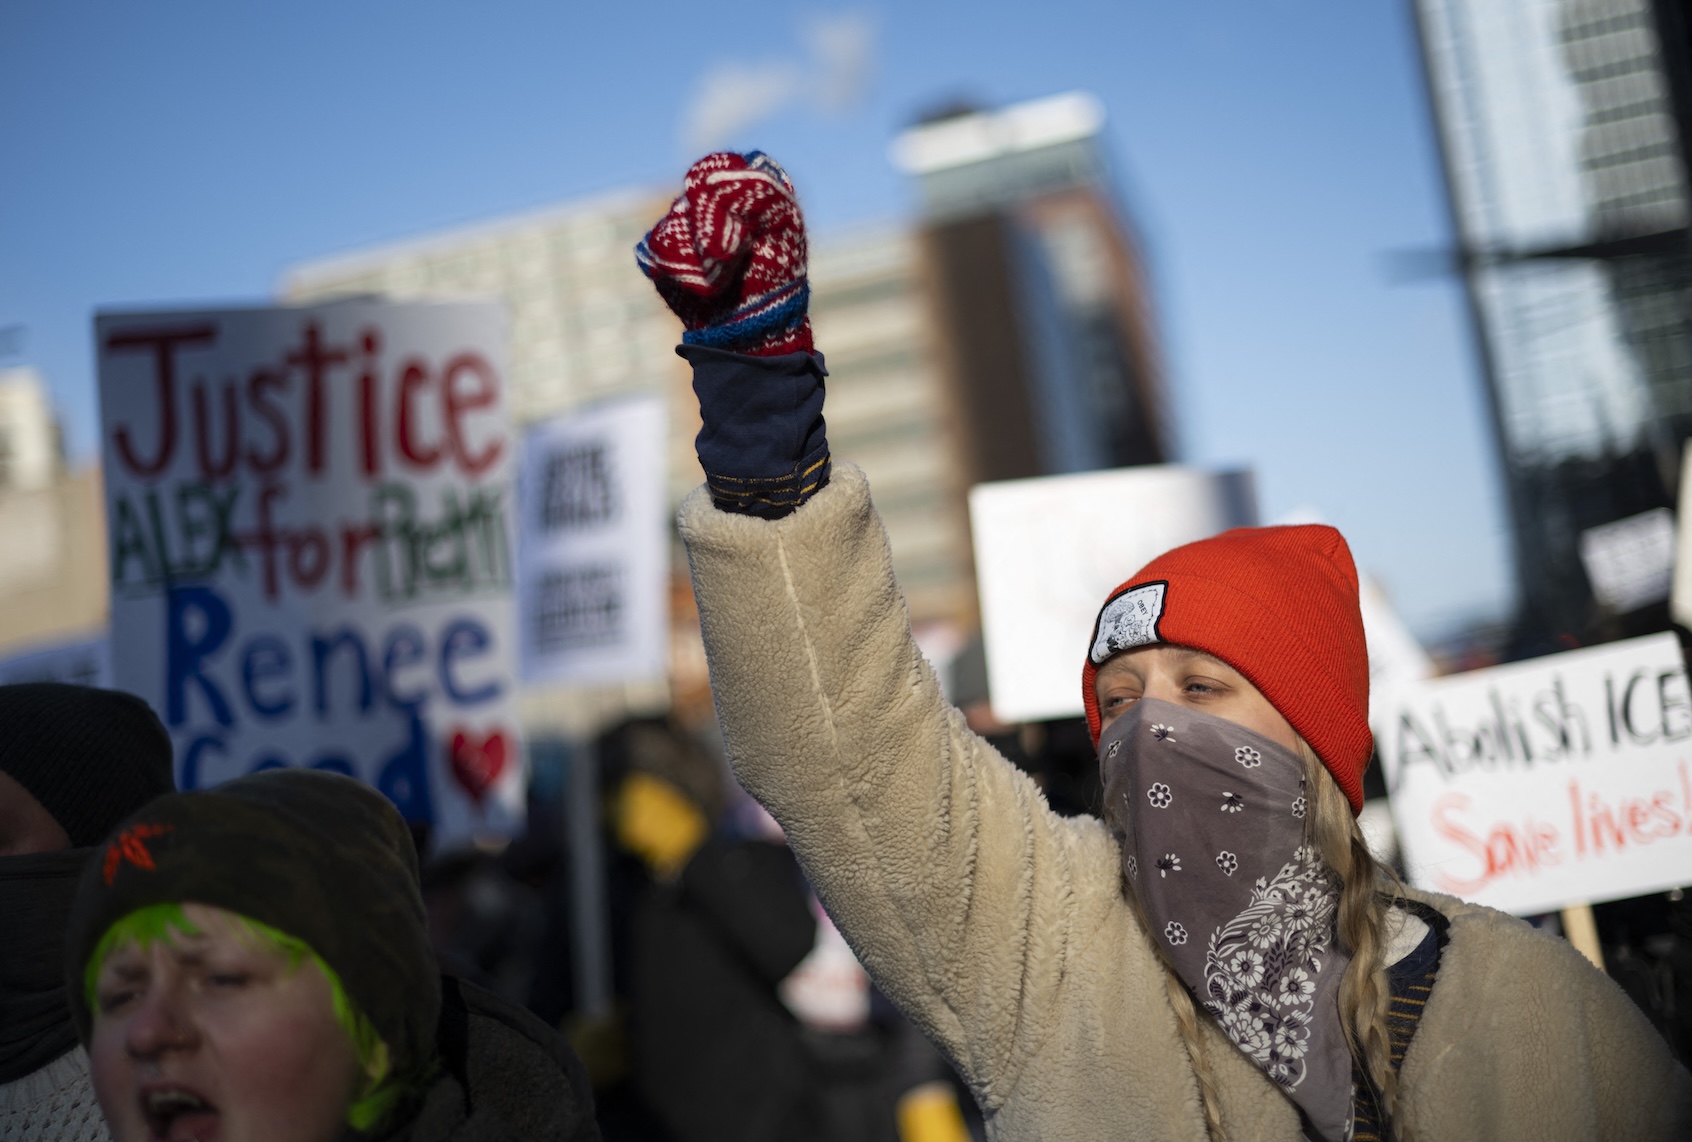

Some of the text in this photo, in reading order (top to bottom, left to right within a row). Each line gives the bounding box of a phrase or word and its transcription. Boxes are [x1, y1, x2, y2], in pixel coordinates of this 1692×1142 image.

[106, 320, 504, 481] Justice
[113, 482, 248, 582] ALEX
[233, 483, 380, 604] for
[167, 586, 506, 728] Renee
[1137, 599, 1148, 615] OBEY
[1395, 668, 1692, 786] Abolish ICE
[1430, 792, 1562, 895] Save
